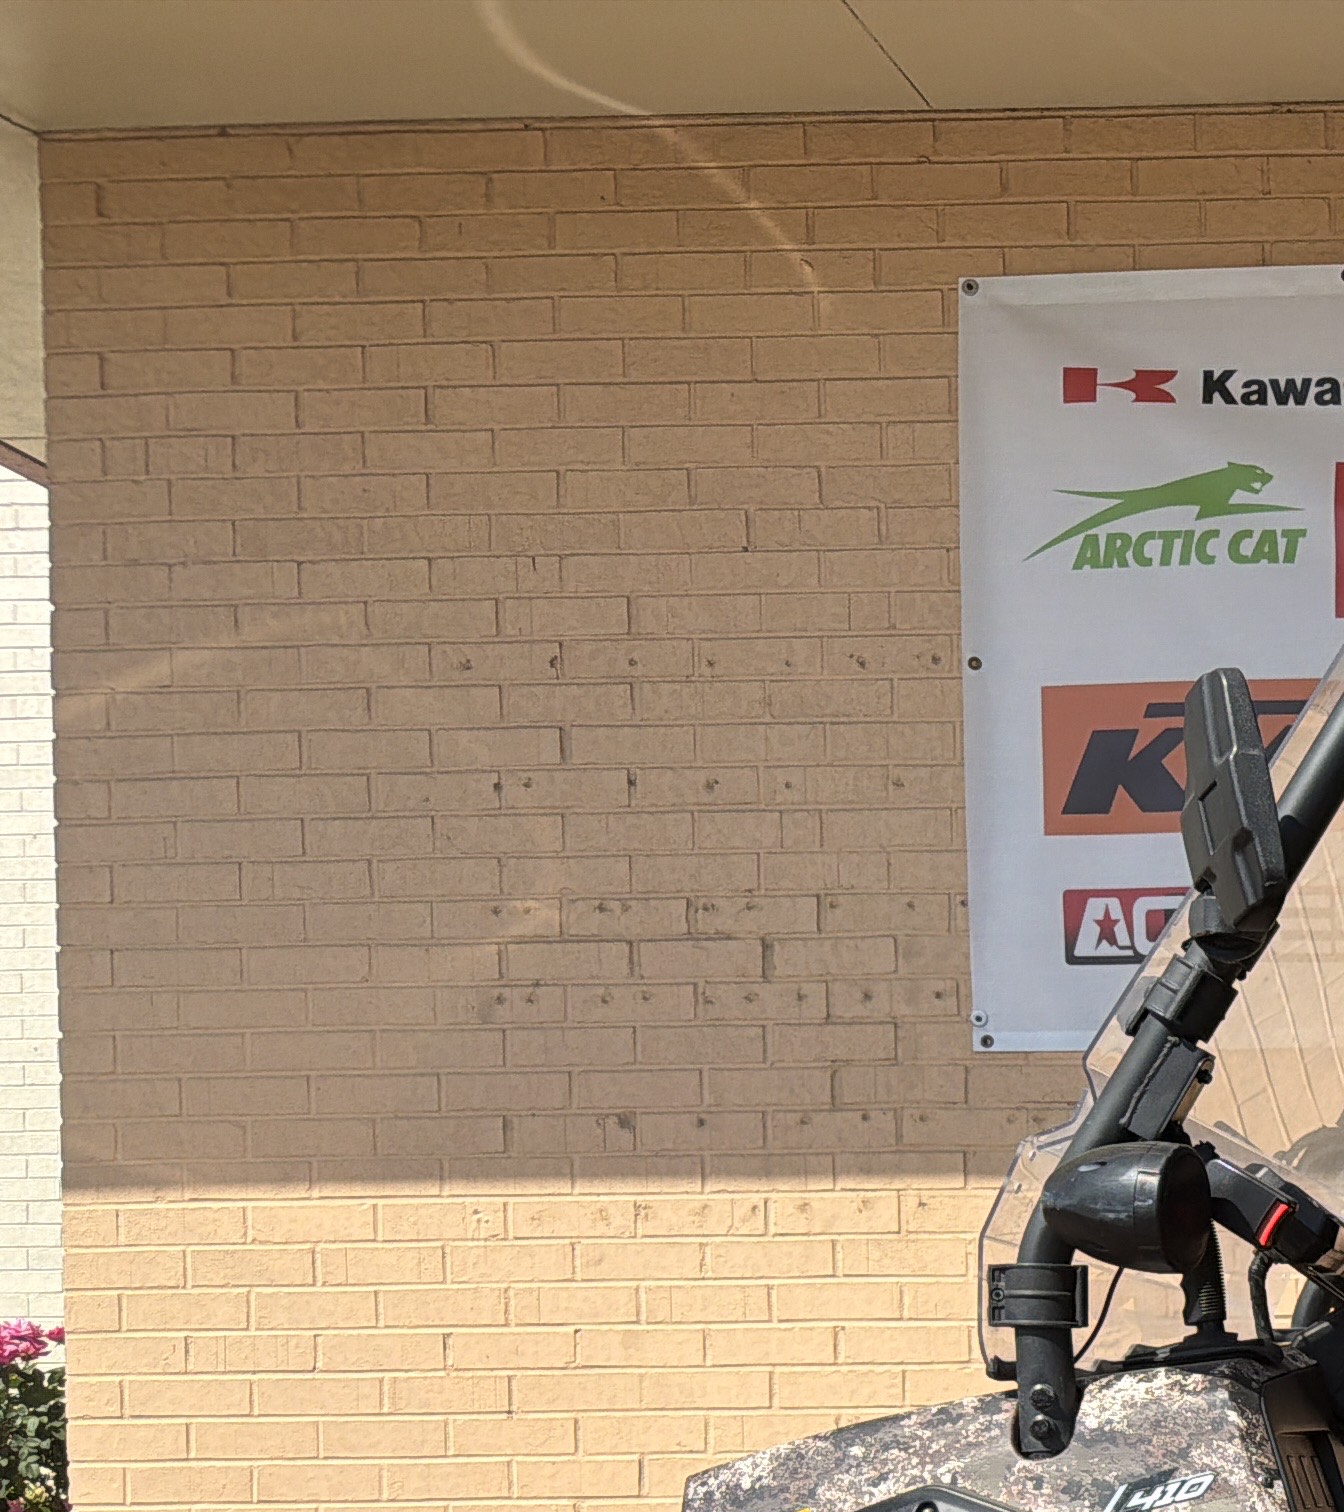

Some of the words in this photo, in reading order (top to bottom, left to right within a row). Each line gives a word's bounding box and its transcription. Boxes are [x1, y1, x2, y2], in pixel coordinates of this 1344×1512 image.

[1072, 528, 1220, 571] ARCTIC
[1226, 527, 1308, 566] CAT
[1125, 1473, 1216, 1512] 410
